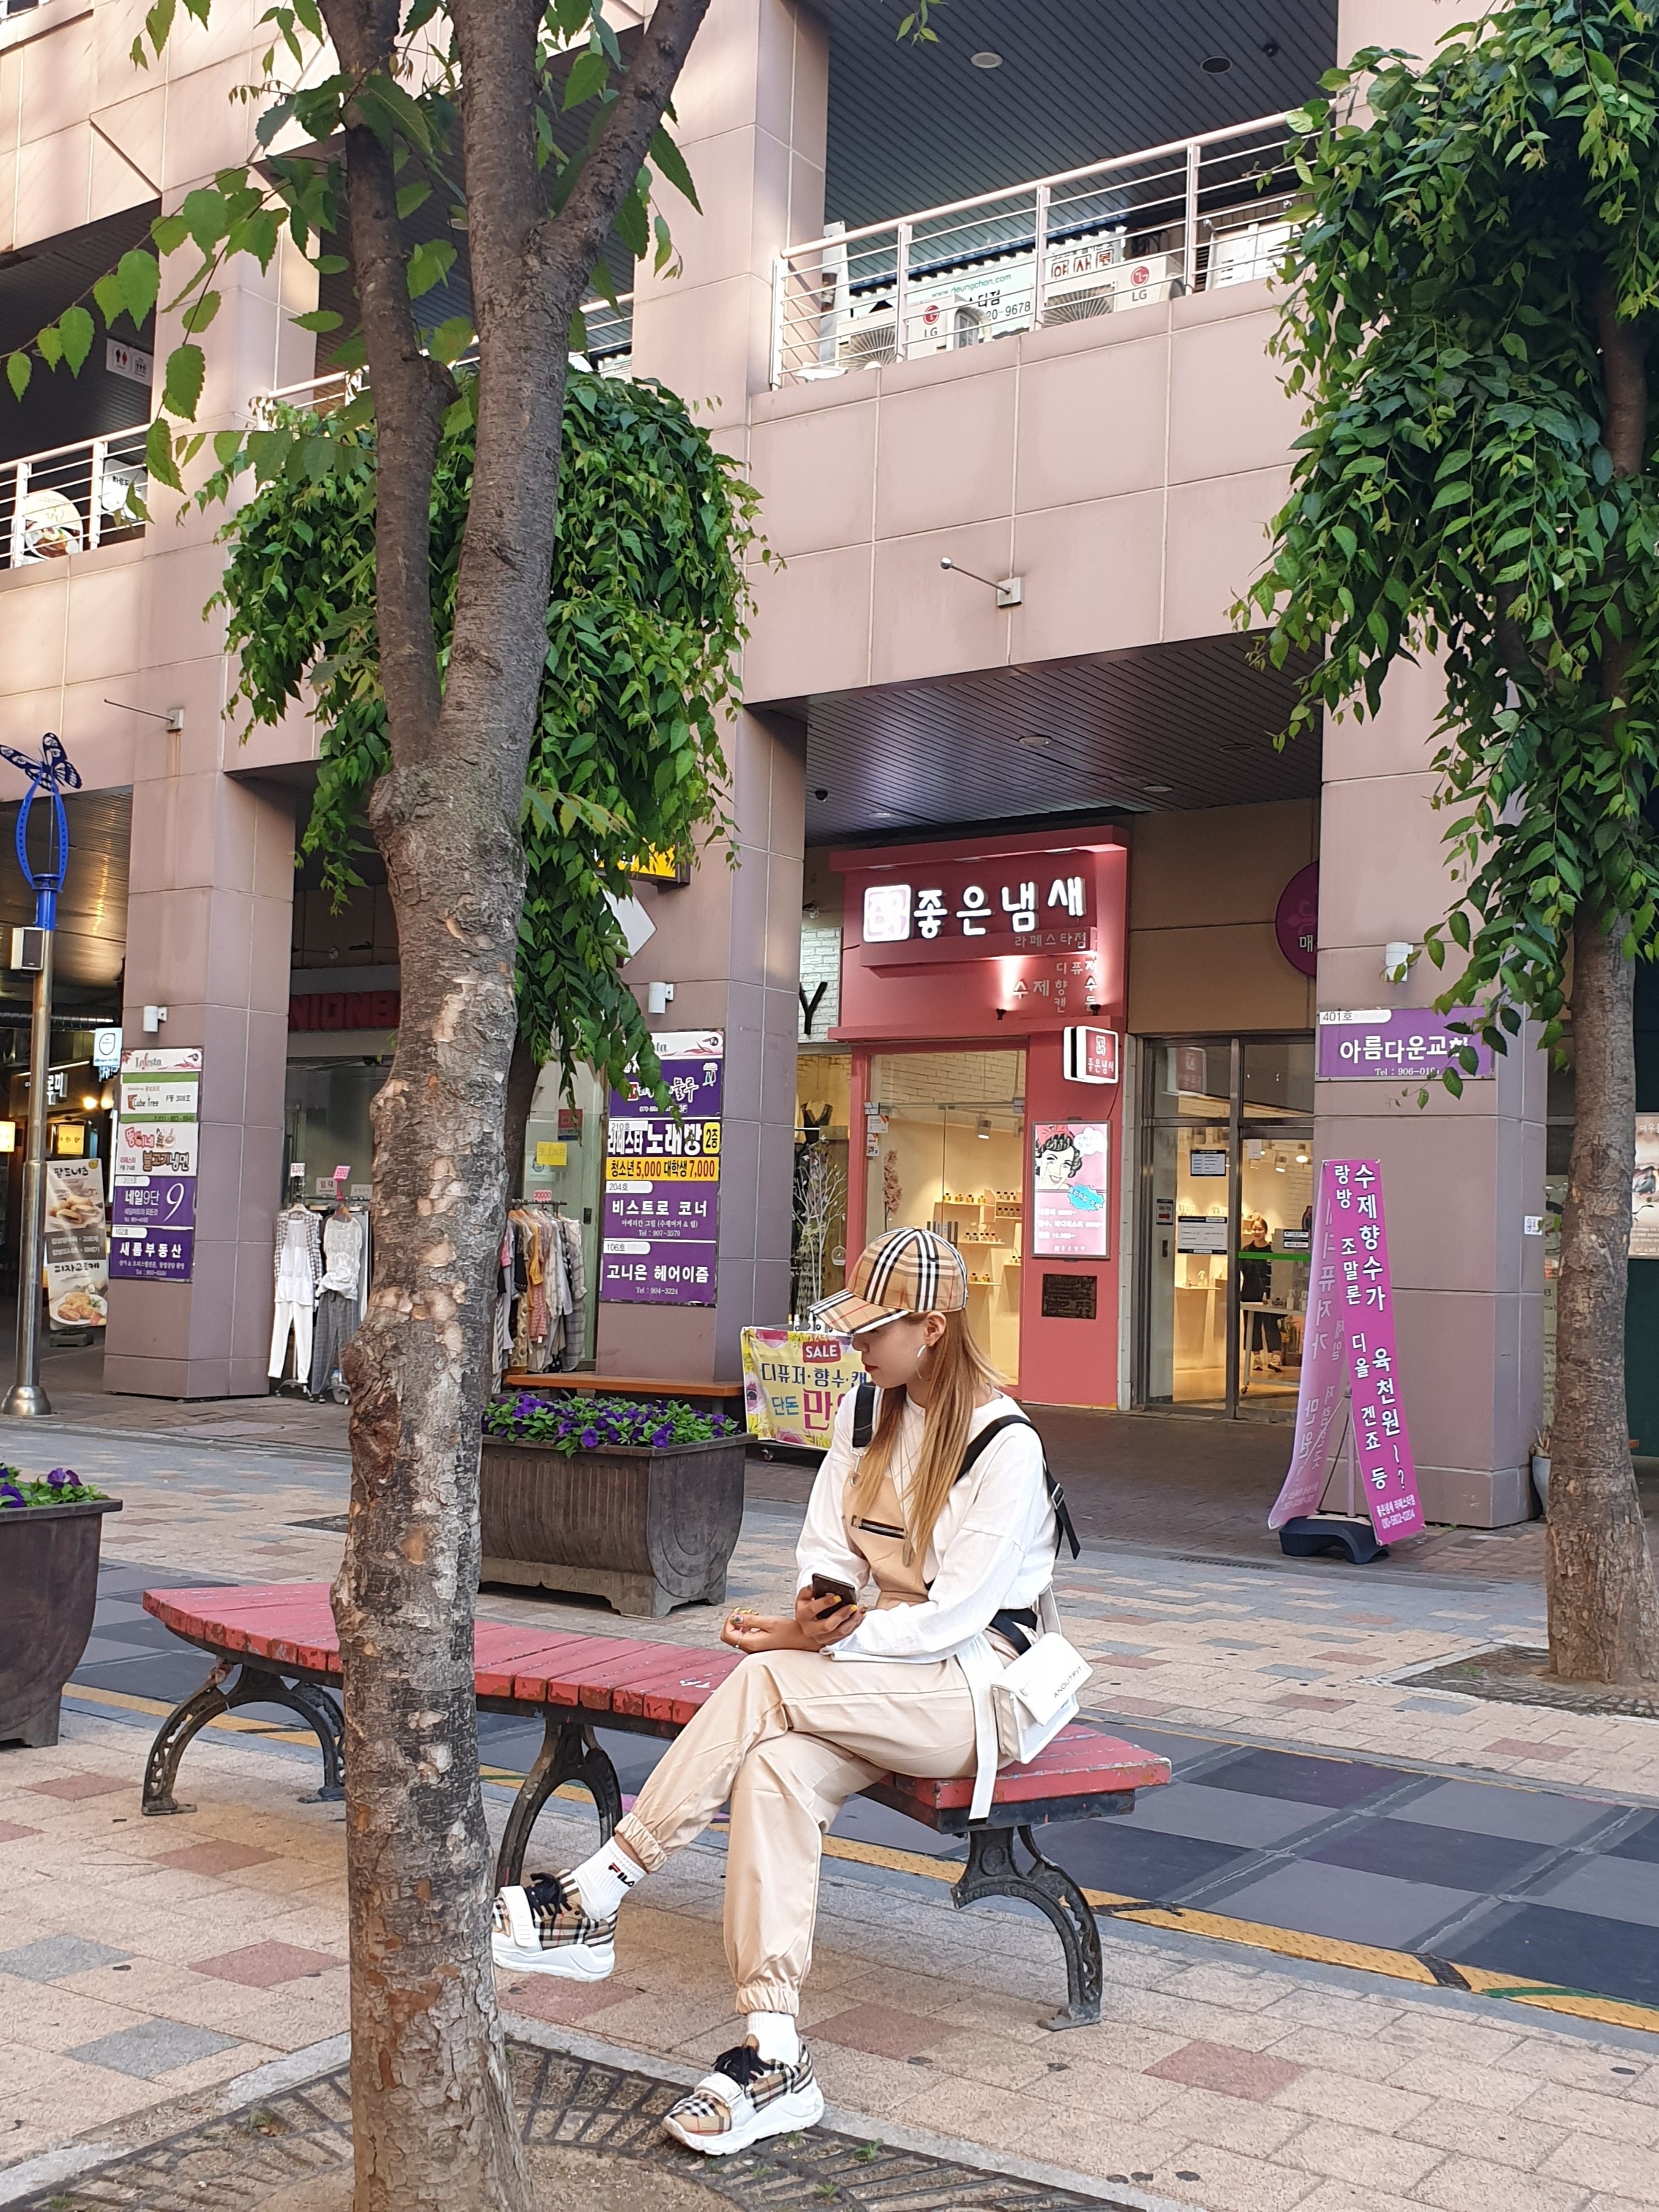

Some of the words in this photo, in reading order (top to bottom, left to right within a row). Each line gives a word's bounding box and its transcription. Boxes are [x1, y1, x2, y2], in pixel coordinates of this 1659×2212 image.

[1132, 290, 1148, 301] LG
[924, 328, 938, 338] LG
[914, 876, 1085, 938] 좋은냄새
[1015, 932, 1087, 949] 라페스타점
[1056, 960, 1097, 975] 디퓨저
[1012, 979, 1050, 999] 수제
[1323, 1012, 1353, 1022] 401호
[1374, 1068, 1388, 1076] Tel
[148, 1096, 159, 1107] Tree
[611, 1122, 631, 1131] 210호
[646, 1123, 703, 1156] 노래방
[705, 1128, 718, 1148] 2층
[611, 1160, 634, 1177] 청소년
[636, 1161, 662, 1179] 5,000
[663, 1160, 688, 1178] 대학생
[689, 1160, 715, 1178] 7,000
[609, 1183, 628, 1191] 204호
[1333, 1165, 1353, 1209] 랑방
[125, 1189, 160, 1205] 네일9단
[162, 1183, 184, 1222] 9
[612, 1200, 669, 1216] 비스트로
[678, 1200, 707, 1217] 코너
[606, 1244, 626, 1252] 106호
[606, 1264, 648, 1281] 고니은
[654, 1265, 710, 1283] 헤어이즘
[1341, 1238, 1362, 1306] 조말론
[805, 1344, 838, 1358] SALE
[1352, 1332, 1370, 1379] 디올
[771, 1396, 800, 1416] 단돈
[1361, 1404, 1382, 1451] 겐죠
[1371, 1467, 1388, 1490] 등
[1053, 1666, 1083, 1698] ANOUTFIT
[609, 1862, 635, 1887] FILA
